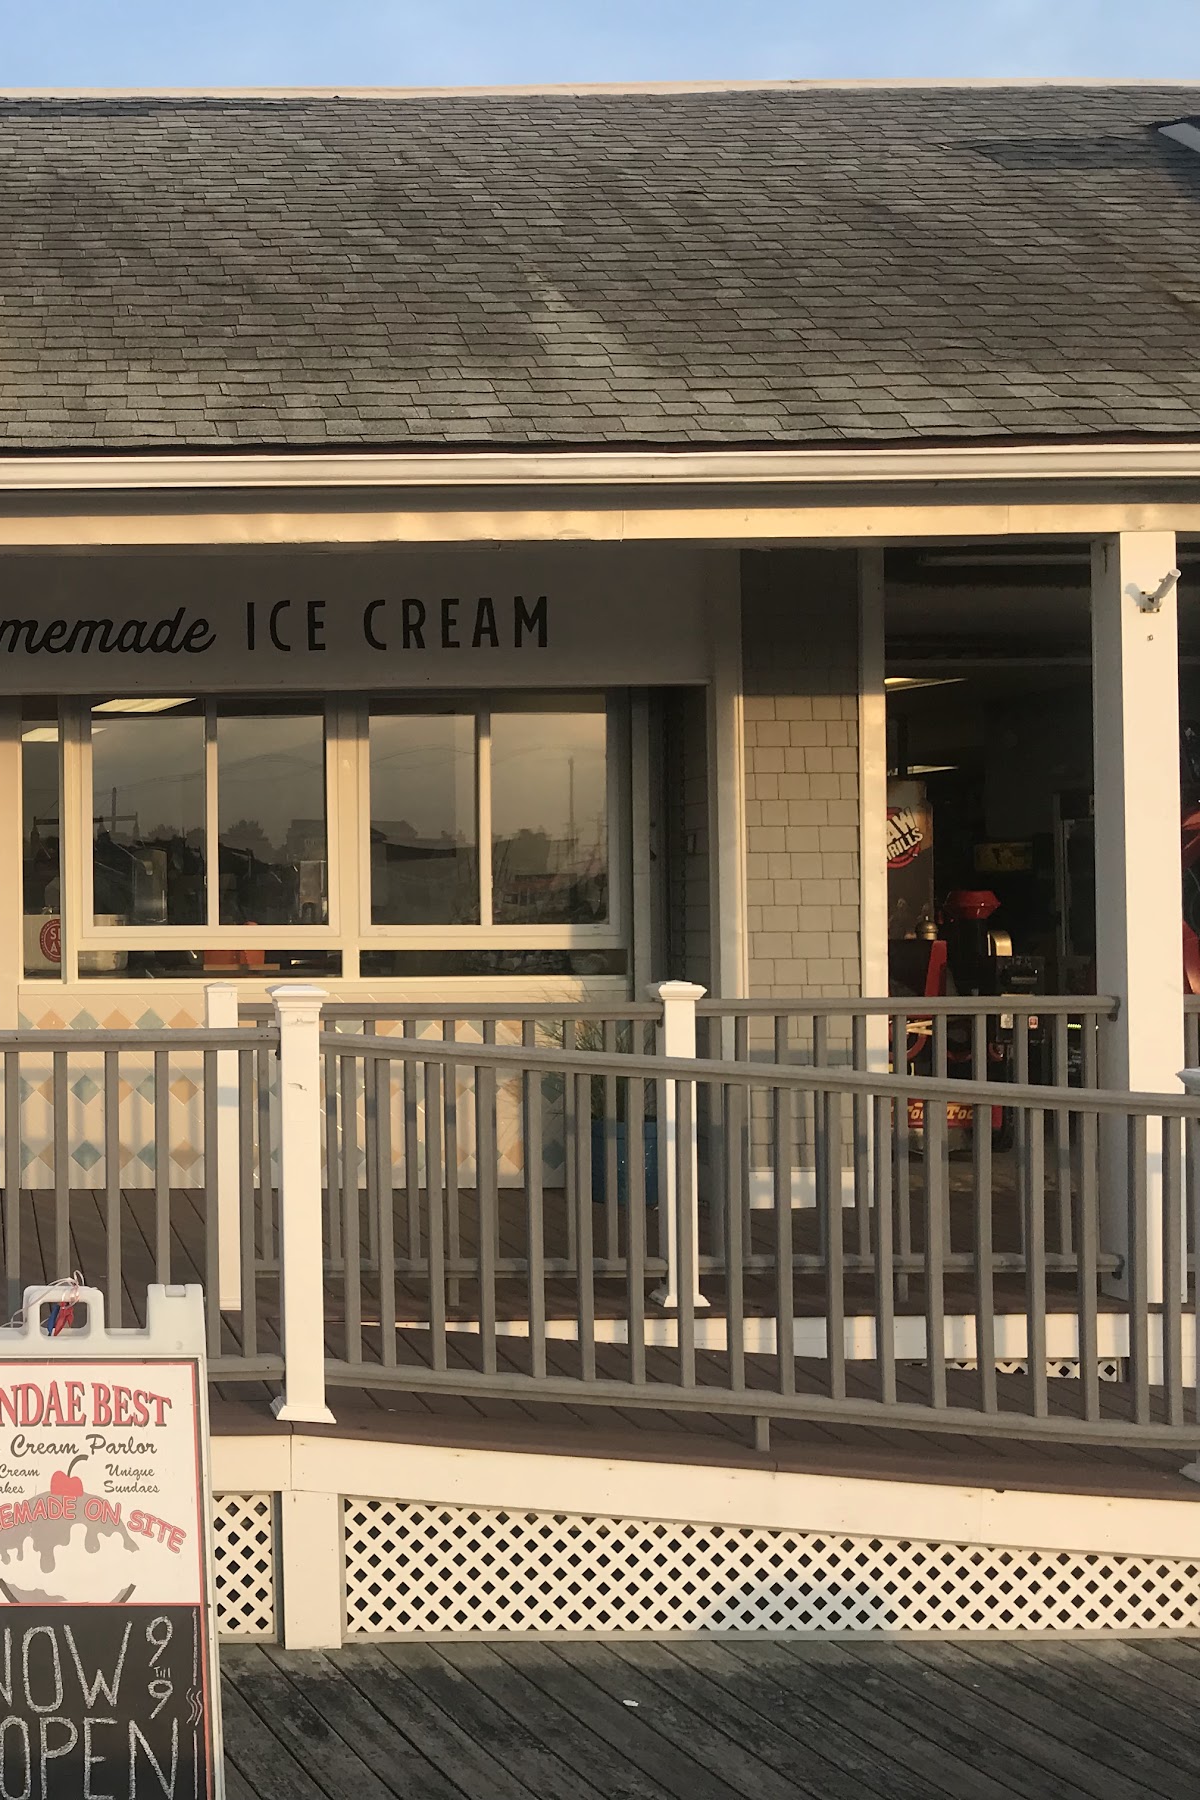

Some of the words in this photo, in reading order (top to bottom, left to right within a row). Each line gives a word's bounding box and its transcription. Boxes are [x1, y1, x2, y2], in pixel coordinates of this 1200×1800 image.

[247, 600, 326, 651] ICE
[363, 595, 548, 650] CREAM
[887, 807, 916, 844] AW
[887, 828, 923, 861] RILLS
[91, 1381, 173, 1427] BEST
[10, 1433, 79, 1455] Cream
[85, 1433, 157, 1455] Parlor
[104, 1480, 160, 1494] Sundaes
[105, 1463, 155, 1480] Unique
[84, 1497, 122, 1526] ON
[126, 1509, 187, 1554] SITE
[146, 1615, 173, 1667] 9
[147, 1680, 173, 1720] 9
